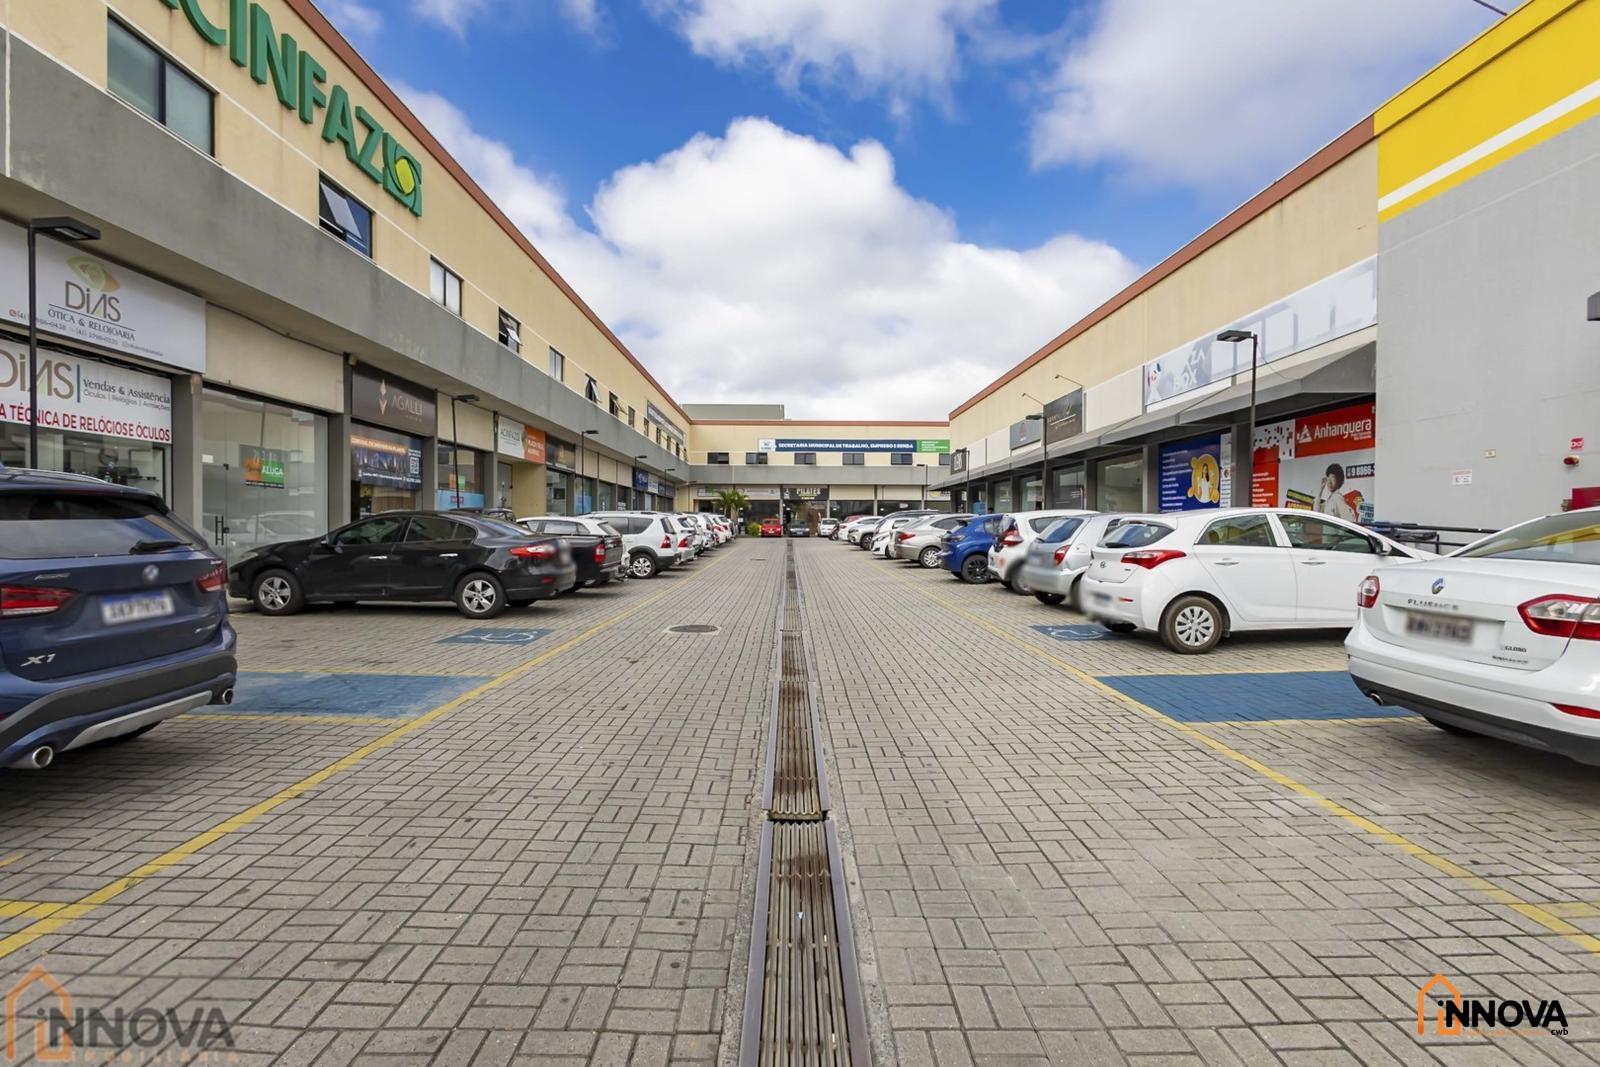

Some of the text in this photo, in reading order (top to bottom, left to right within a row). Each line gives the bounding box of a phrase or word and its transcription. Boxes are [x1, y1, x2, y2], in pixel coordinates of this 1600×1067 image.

[78, 319, 85, 327] &
[83, 378, 171, 405] Vendas & Assistência
[63, 412, 77, 429] DE
[136, 421, 170, 442] ÓCULOS
[1313, 419, 1372, 440] Anhanguera
[21, 653, 56, 667] X1
